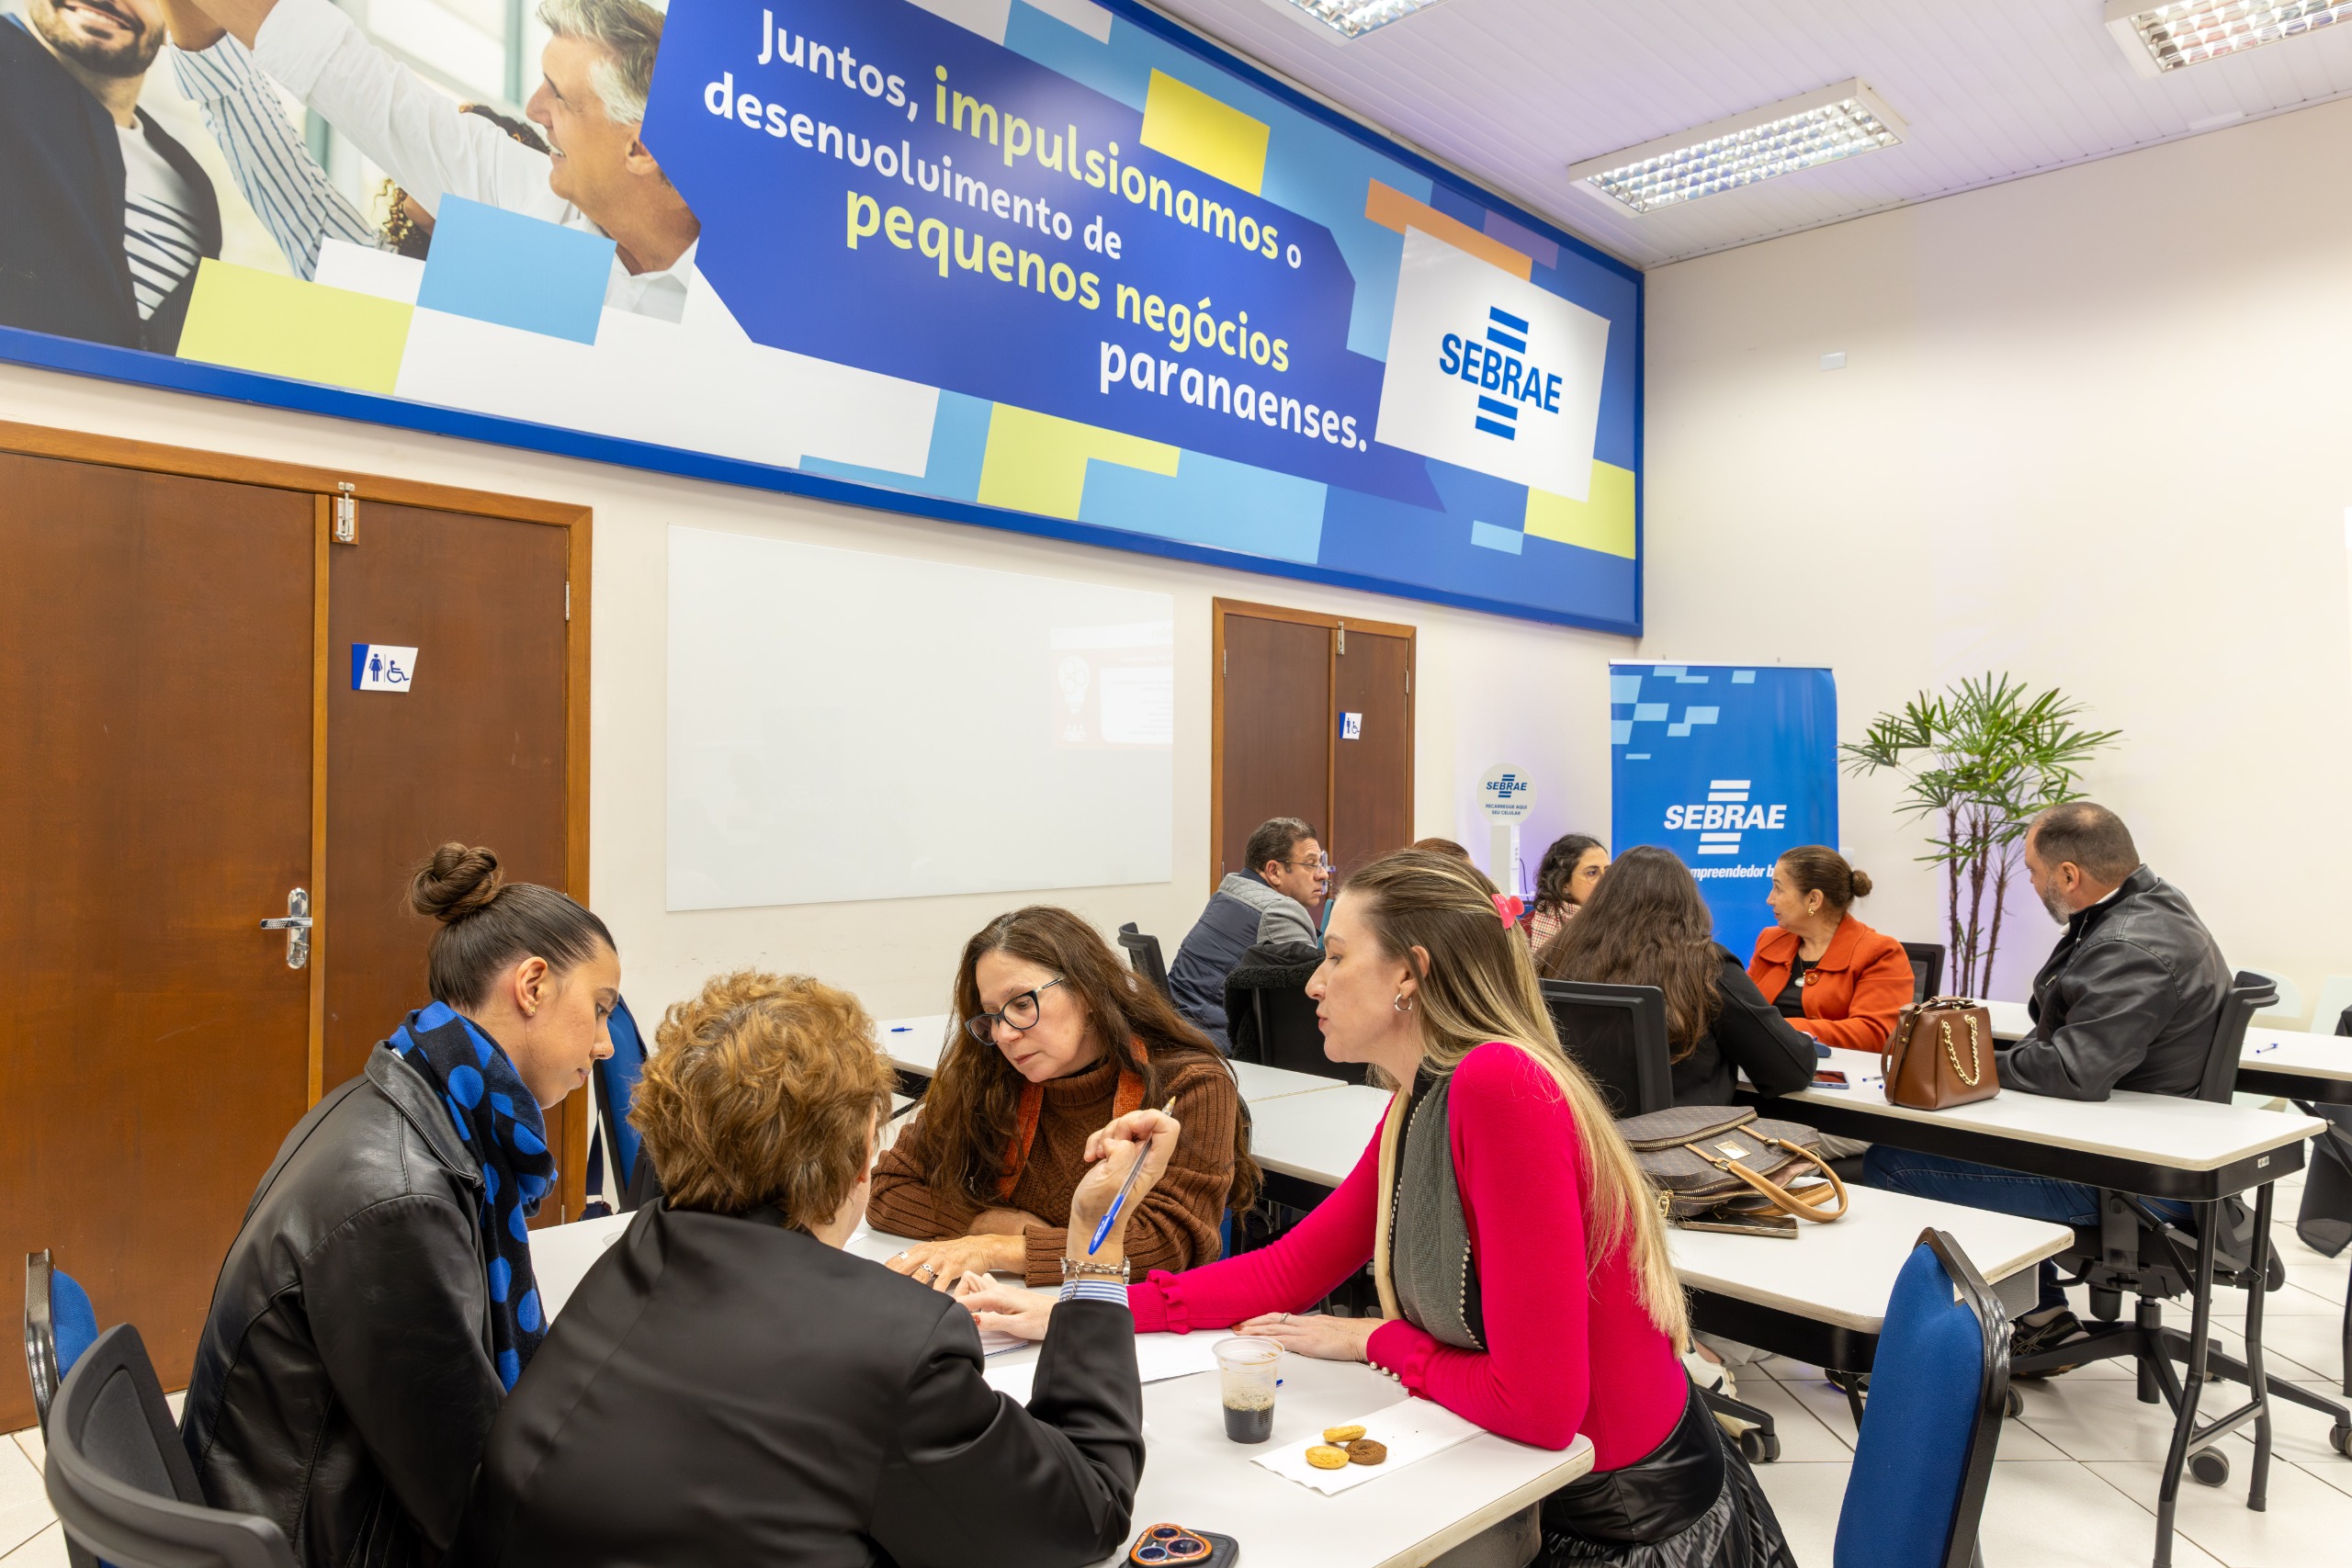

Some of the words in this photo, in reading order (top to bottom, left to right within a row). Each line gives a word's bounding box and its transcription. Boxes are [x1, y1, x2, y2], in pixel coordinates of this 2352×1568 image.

[704, 72, 1073, 241] desenvolvimento
[1083, 214, 1122, 260] de
[758, 9, 919, 123] Juntos,
[935, 65, 1279, 260] impulsionamos
[1286, 243, 1302, 269] o
[846, 190, 1101, 310] pequenos
[1116, 283, 1290, 372] negócios
[1100, 341, 1367, 453] paranaenses.
[1440, 333, 1563, 414] SEBRAE
[1486, 782, 1527, 790] SEBRAE
[1663, 804, 1787, 829] SEBRAE
[1690, 864, 1765, 881] mpreendedor
